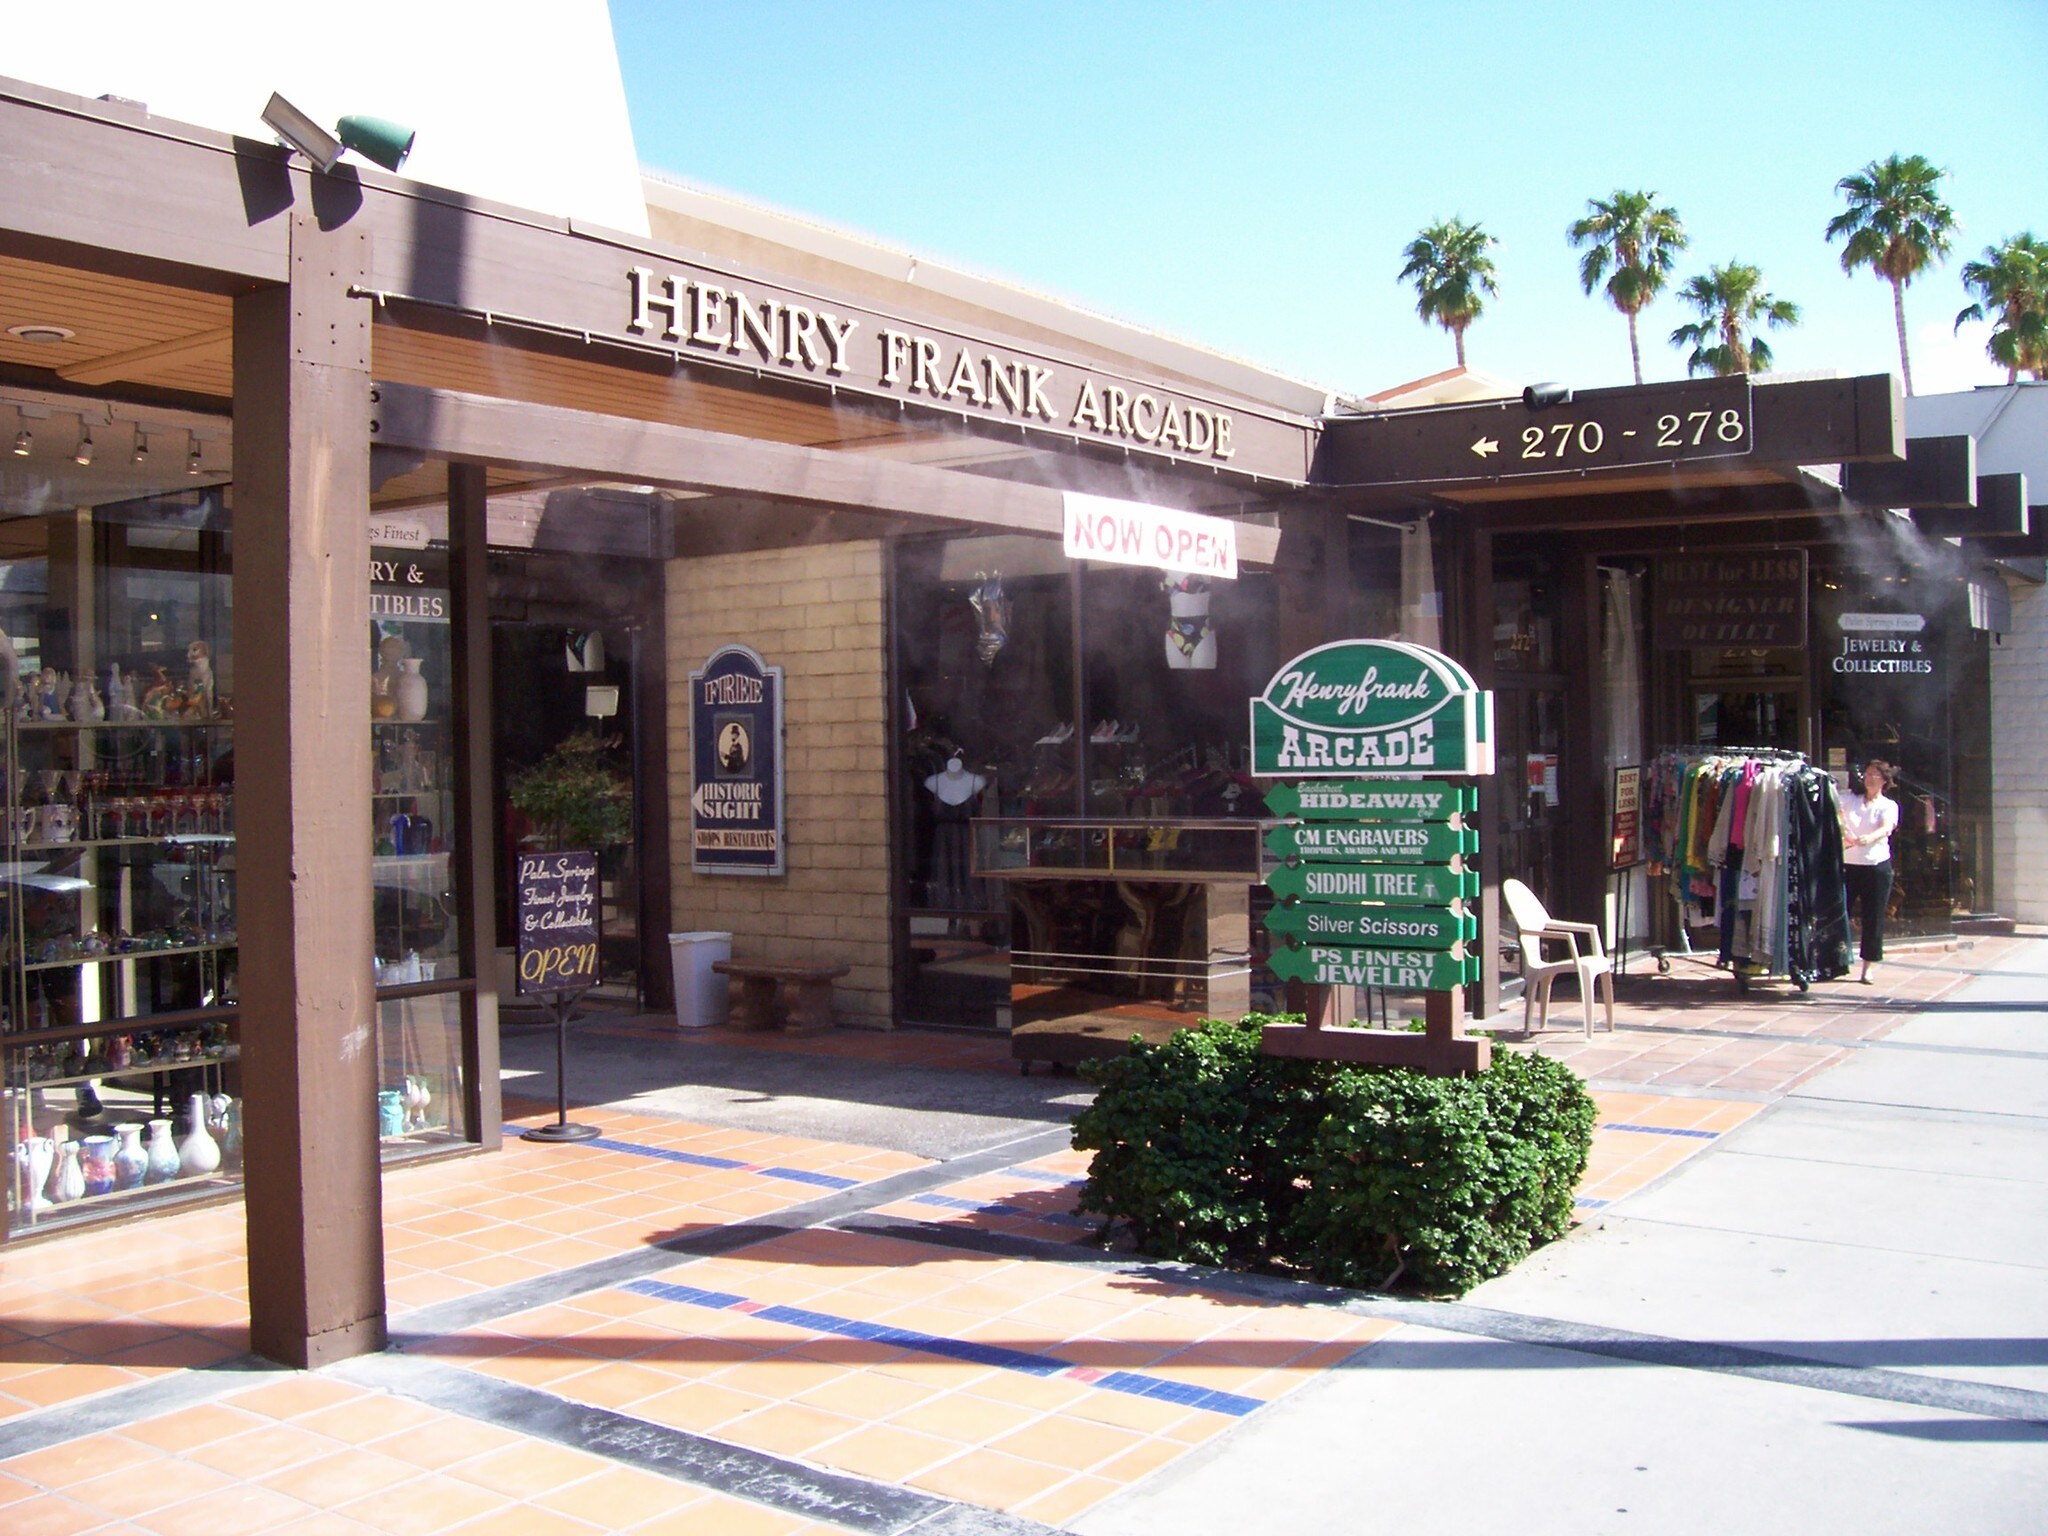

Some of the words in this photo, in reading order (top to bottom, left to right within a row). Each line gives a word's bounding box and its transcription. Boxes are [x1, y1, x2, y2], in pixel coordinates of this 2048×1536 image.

[629, 264, 860, 374] HENRY
[880, 327, 1058, 420] FRANK
[1072, 378, 1236, 459] ARCADE
[1521, 420, 1605, 460] 270
[1656, 408, 1745, 448] 278
[384, 525, 420, 540] Finest
[1074, 512, 1144, 556] NOW
[1155, 524, 1228, 571] OPEN
[407, 564, 424, 583] &
[1750, 558, 1800, 580] LESS
[1681, 623, 1781, 640] OUTLET
[1842, 636, 1906, 656] JEWELRY
[1911, 639, 1922, 653] &
[1832, 656, 1933, 674] COLLECTIBLES
[704, 673, 764, 706] FREE
[1277, 717, 1435, 768] ARCADE
[1618, 773, 1638, 784] BEST
[703, 782, 764, 802] HISTORIC
[1299, 793, 1444, 809] HIDEAWAY
[1620, 786, 1635, 797] FOR
[702, 801, 763, 821] SIGHT
[1618, 798, 1637, 810] LESS
[696, 830, 721, 847] SHOPS
[723, 830, 776, 849] RESTAURANTS
[1294, 829, 1320, 846] CM
[1326, 829, 1429, 846] ENGRAVERS
[1344, 846, 1379, 856] AWARDS
[1380, 847, 1398, 856] AND
[1399, 847, 1424, 856] MORE
[520, 859, 551, 885] Palm
[552, 858, 595, 881] Springs
[1306, 872, 1367, 895] SIDDHI
[1372, 873, 1418, 896] TREE
[522, 887, 556, 907] Finest
[556, 883, 594, 908] Jewelry
[524, 914, 539, 932] &
[540, 909, 593, 931] Collectibles
[1307, 914, 1354, 934] Silver
[1359, 916, 1439, 937] Scissors
[520, 943, 597, 984] OPEN
[1311, 948, 1343, 964] PS
[1351, 950, 1437, 968] FINEST
[1314, 964, 1434, 988] JEWELRY
